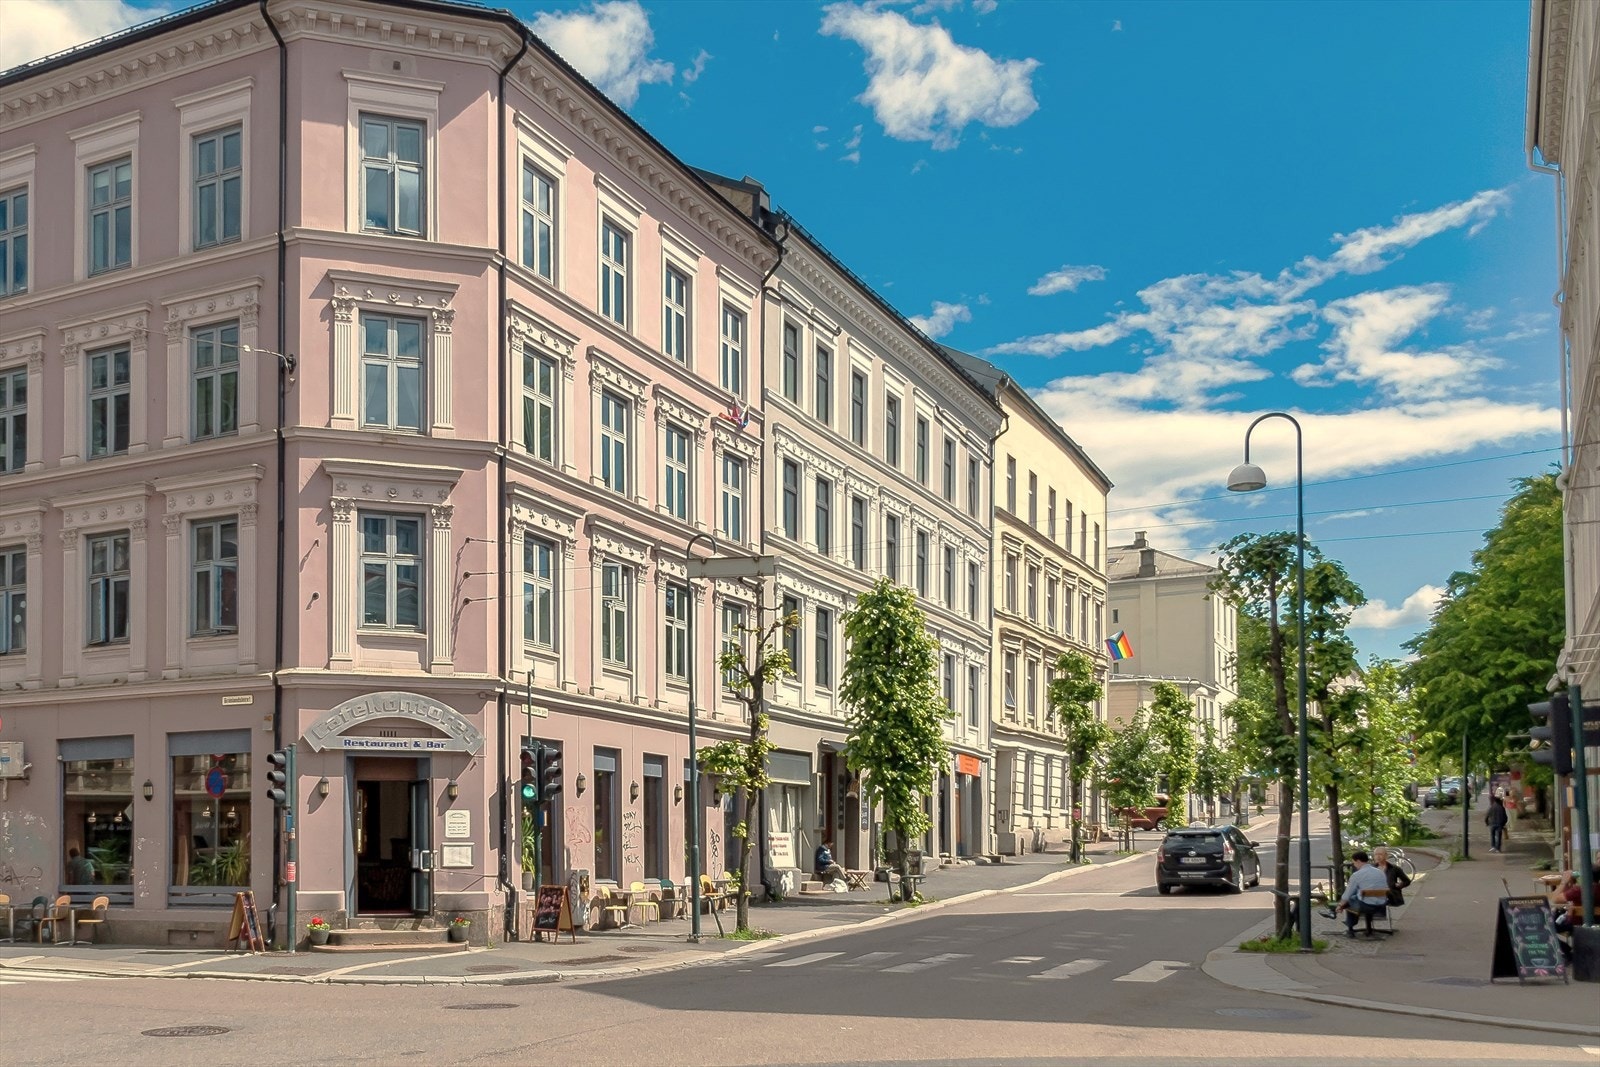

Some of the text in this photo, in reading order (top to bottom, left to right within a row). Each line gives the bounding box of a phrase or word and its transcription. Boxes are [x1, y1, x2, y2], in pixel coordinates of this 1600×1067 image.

[343, 739, 446, 749] Restaurant & Bar
